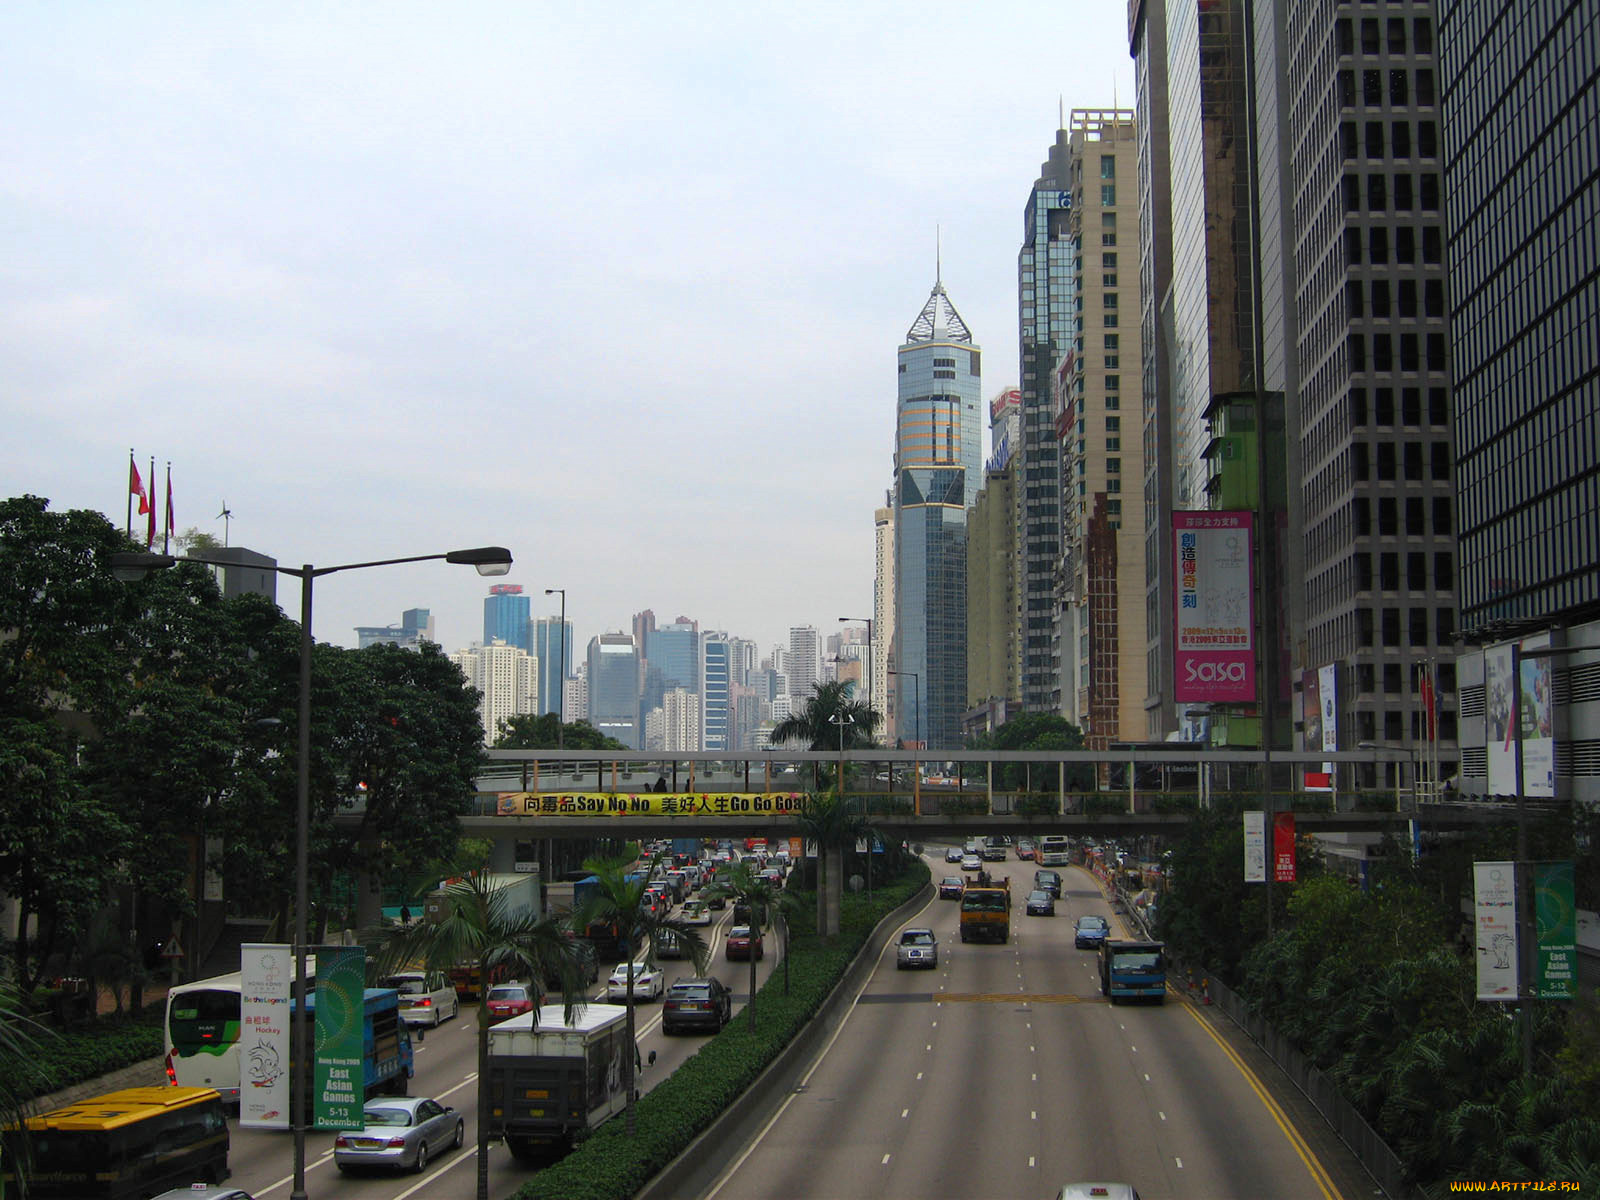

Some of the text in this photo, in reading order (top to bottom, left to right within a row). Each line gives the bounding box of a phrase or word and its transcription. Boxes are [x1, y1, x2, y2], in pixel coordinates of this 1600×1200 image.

[1181, 532, 1197, 608] 創造傳奇一刻
[577, 796, 604, 812] Say
[608, 797, 627, 811] No
[631, 797, 650, 811] No
[661, 796, 729, 812] 美好人生
[731, 796, 749, 811] Go
[754, 796, 771, 811] Go
[1550, 952, 1566, 961] East
[1547, 962, 1568, 970] Asian
[1545, 971, 1571, 979] Games
[256, 1026, 281, 1035] Hockey
[329, 1067, 349, 1079] East
[326, 1079, 353, 1091] Asian
[323, 1091, 356, 1103] Games
[329, 1107, 349, 1117] 5-13
[317, 1116, 361, 1127] December
